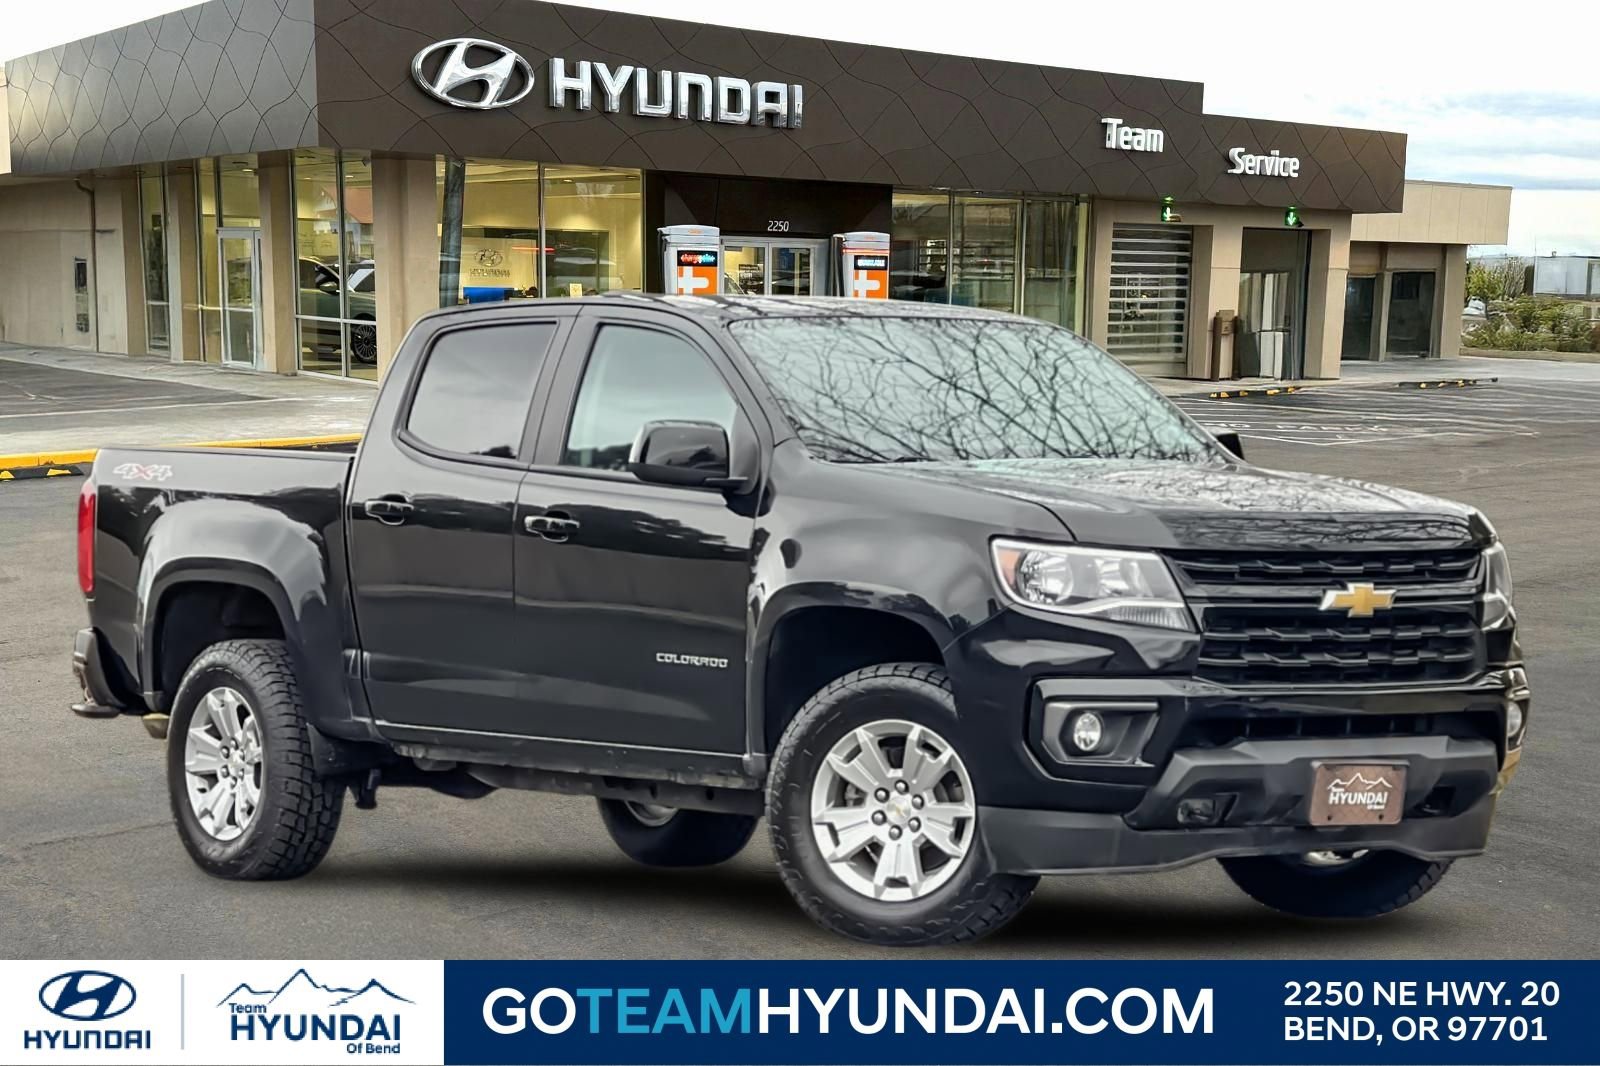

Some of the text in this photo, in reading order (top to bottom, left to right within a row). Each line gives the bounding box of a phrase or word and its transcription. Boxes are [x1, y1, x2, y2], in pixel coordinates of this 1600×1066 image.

[549, 57, 803, 129] HYUNDAI
[1101, 117, 1164, 152] Team
[1227, 147, 1300, 178] Service
[767, 220, 790, 232] 2250
[656, 653, 728, 668] COLORADO
[1328, 791, 1389, 805] HYUNDAI
